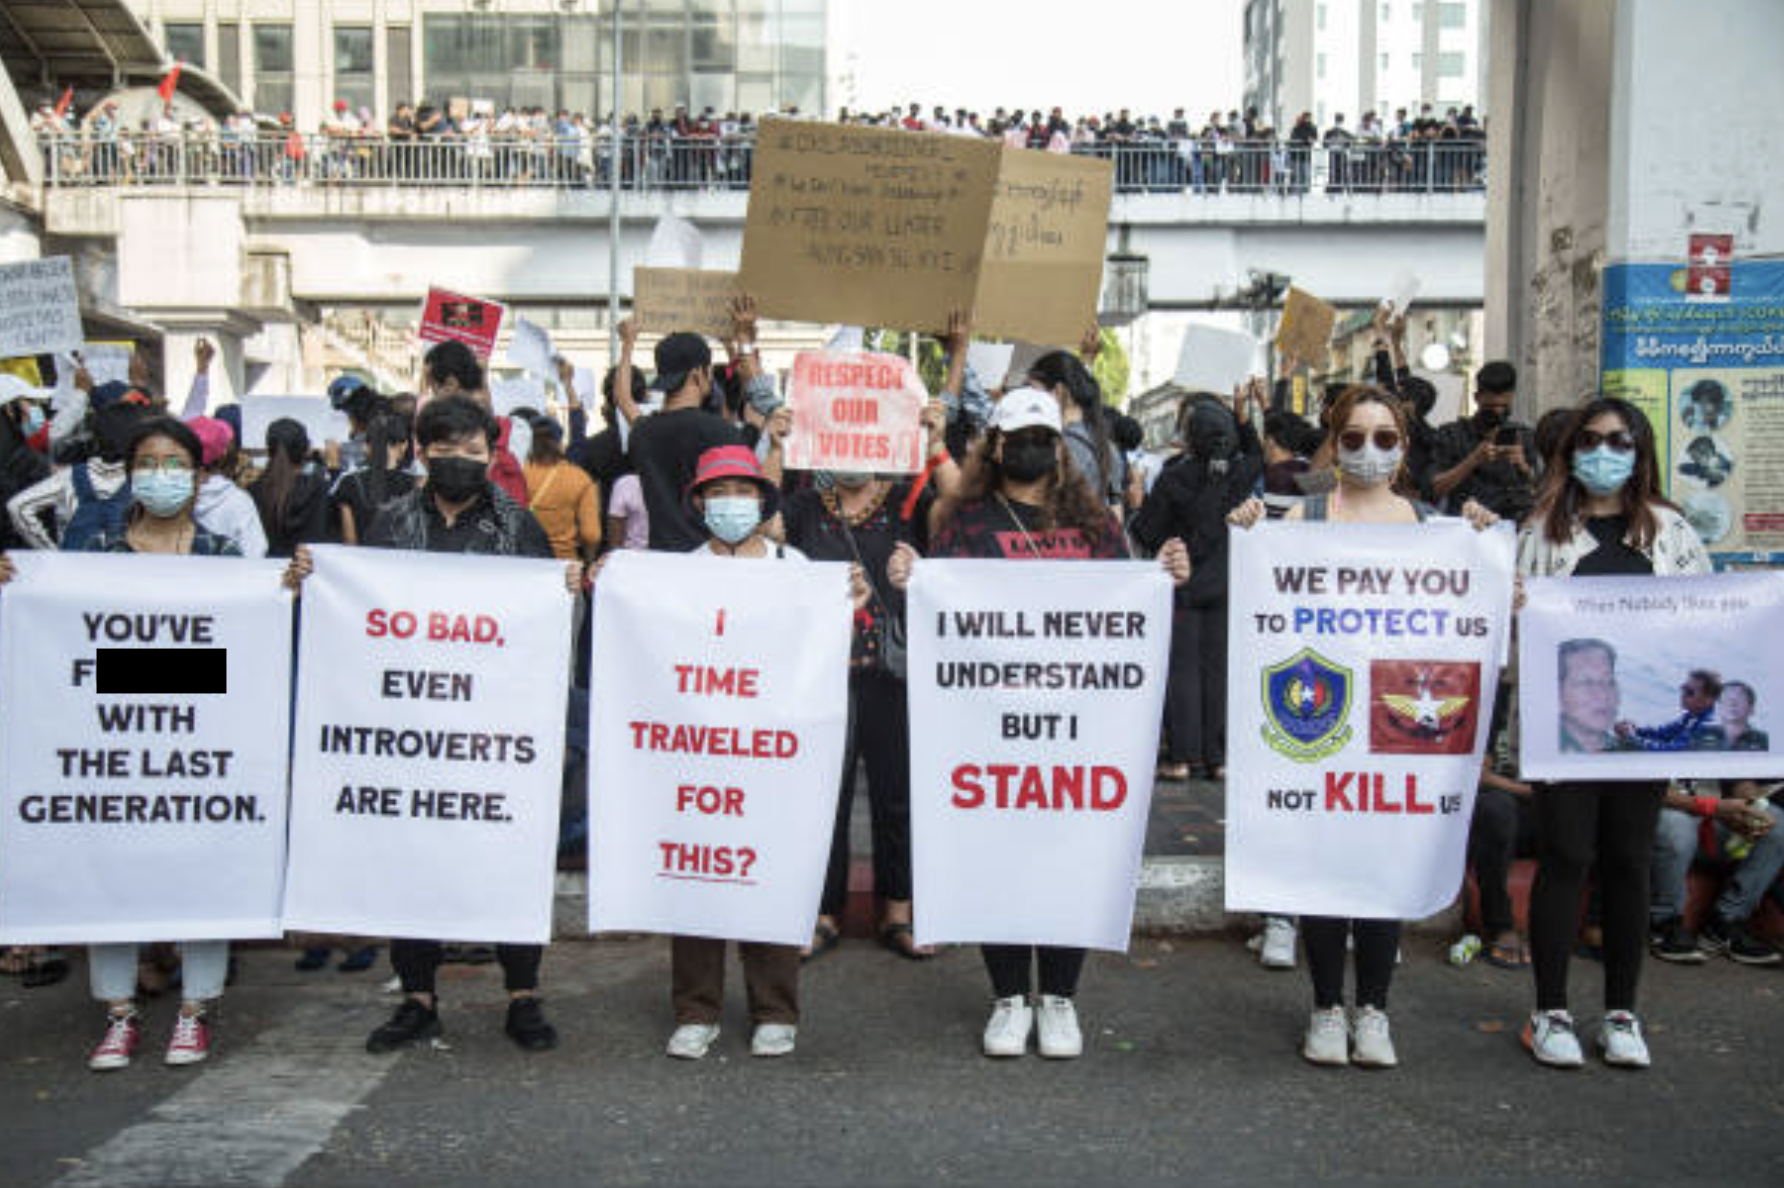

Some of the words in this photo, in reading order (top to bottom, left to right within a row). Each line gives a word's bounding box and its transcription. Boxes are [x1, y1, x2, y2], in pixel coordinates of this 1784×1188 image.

[808, 363, 904, 391] RESPECT
[832, 398, 878, 425] OUR
[818, 433, 889, 458] VOTES
[1273, 567, 1327, 594] WE
[1337, 567, 1392, 594] PAY
[1403, 569, 1469, 597] YOU
[83, 612, 213, 644] YOU'VE
[366, 608, 417, 639] SO
[427, 613, 504, 647] BAD,
[716, 610, 724, 636] I
[937, 612, 946, 637] I
[954, 611, 1035, 638] WILL
[1044, 612, 1146, 638] NEVER
[1254, 614, 1286, 633] TO
[1294, 606, 1448, 636] PROTECT
[1456, 617, 1488, 637] US
[381, 670, 472, 701] EVEN
[675, 665, 759, 698] TIME
[936, 662, 1144, 689] UNDERSTAND
[97, 704, 195, 733] WITH
[1002, 713, 1061, 740] BUT
[1070, 715, 1077, 740] I
[320, 725, 536, 764] INTROVERTS
[629, 721, 798, 758] TRAVELED
[57, 749, 130, 778] THE
[141, 750, 233, 778] LAST
[677, 785, 744, 816] FOR
[951, 764, 1127, 811] STAND
[1267, 790, 1317, 811] NOT
[1325, 772, 1434, 814] KILL
[19, 795, 265, 823] GENERATION.
[336, 786, 402, 817] ARE
[411, 789, 512, 822] HERE.
[660, 842, 756, 876] THIS?
